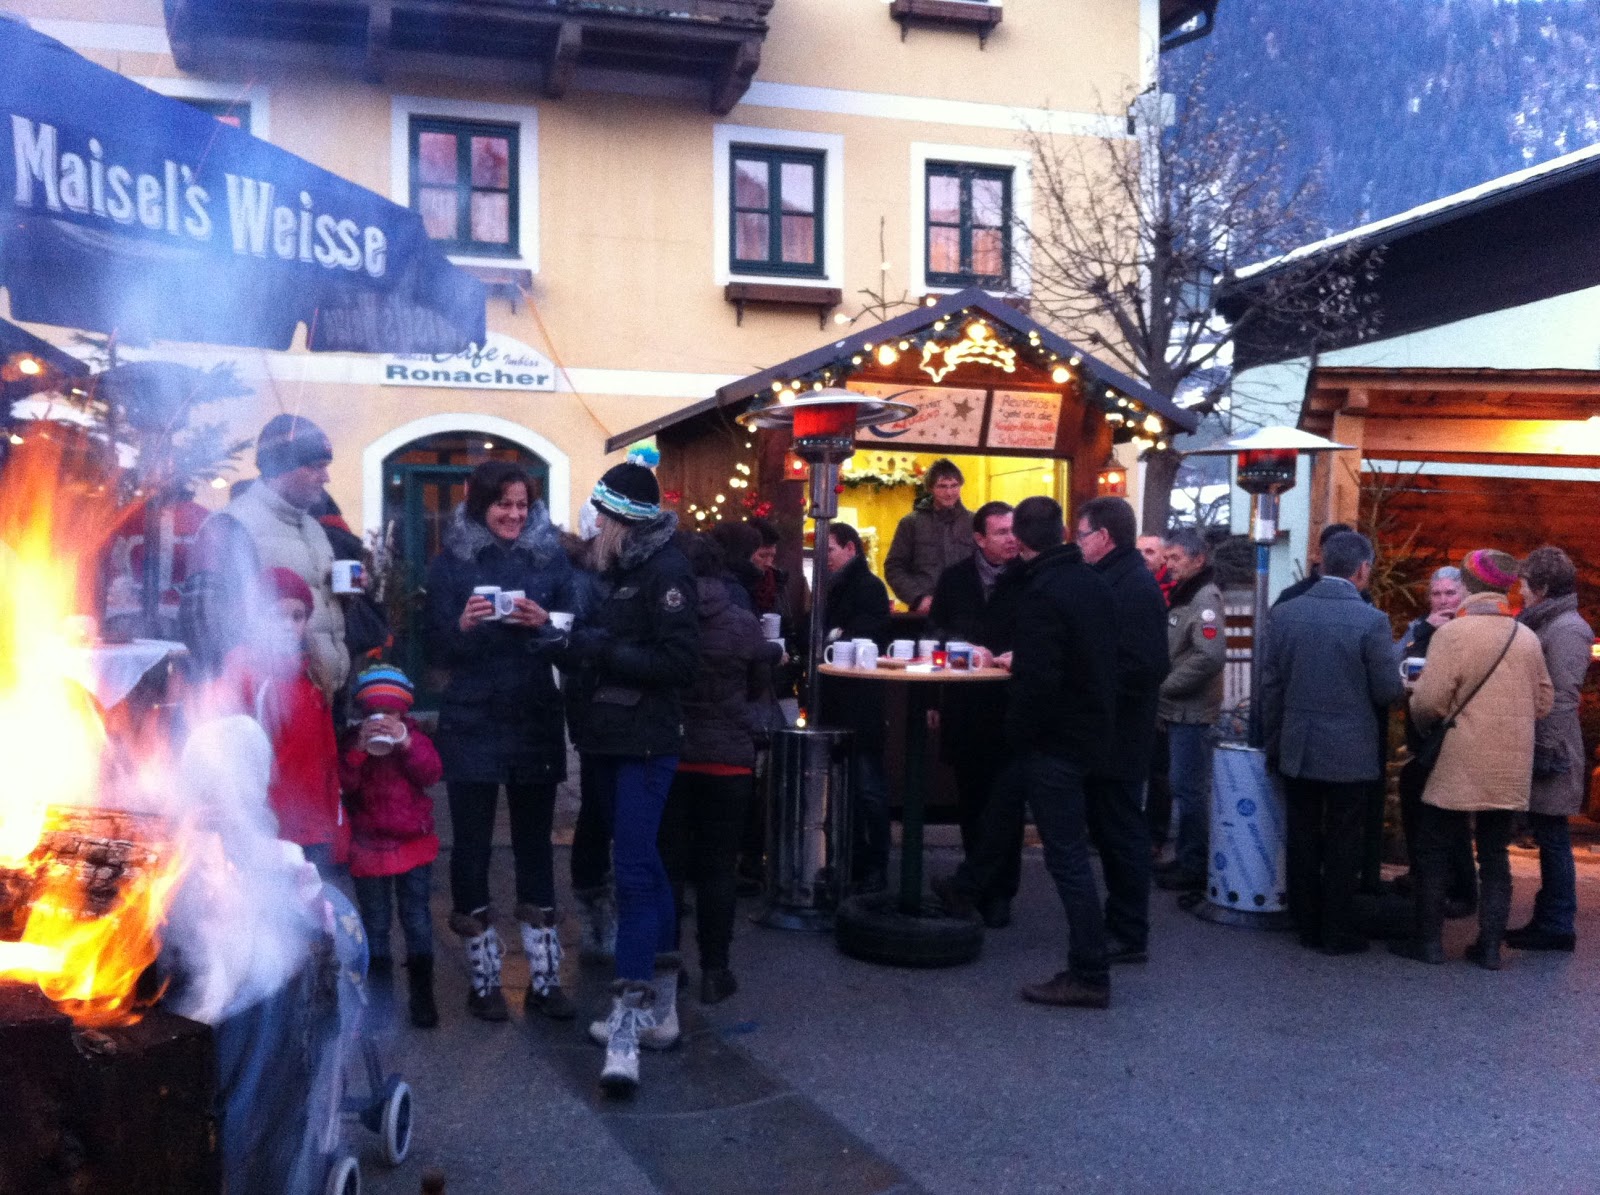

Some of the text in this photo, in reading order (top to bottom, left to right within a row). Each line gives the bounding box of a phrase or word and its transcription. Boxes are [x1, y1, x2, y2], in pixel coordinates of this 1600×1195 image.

[10, 113, 387, 278] Maisel's Weisse
[386, 364, 549, 385] Ronacher
